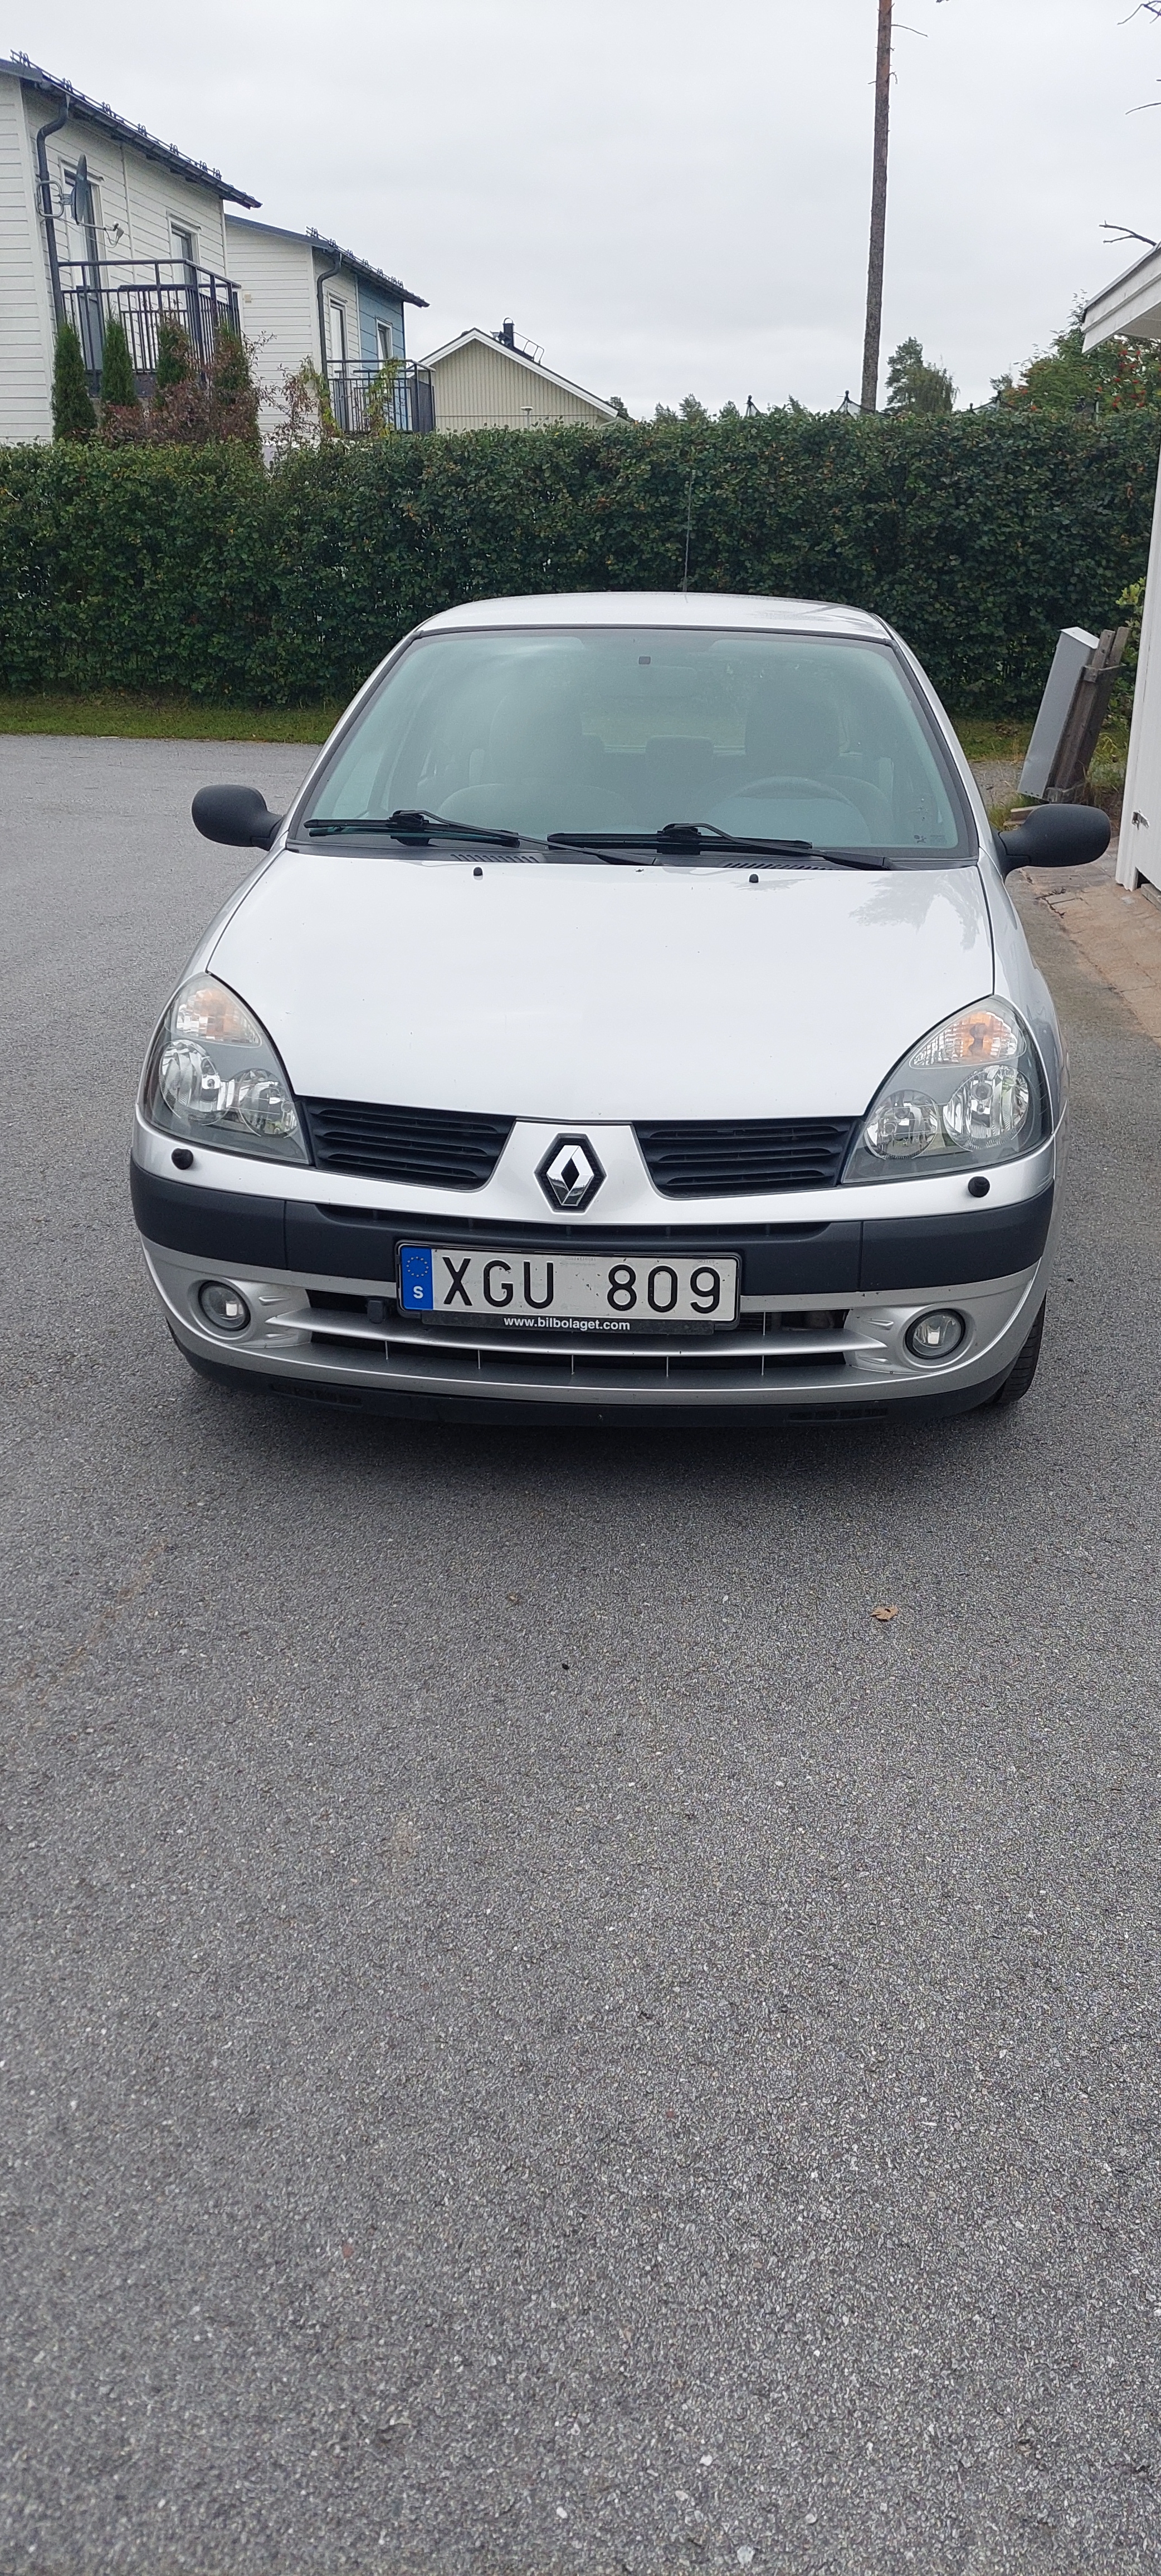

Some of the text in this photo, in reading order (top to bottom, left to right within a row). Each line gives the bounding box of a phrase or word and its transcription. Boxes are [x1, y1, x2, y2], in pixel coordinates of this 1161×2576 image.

[442, 1256, 721, 1313] XGU 809
[413, 1285, 423, 1299] S
[504, 1317, 630, 1331] www.bilbolaget.com
